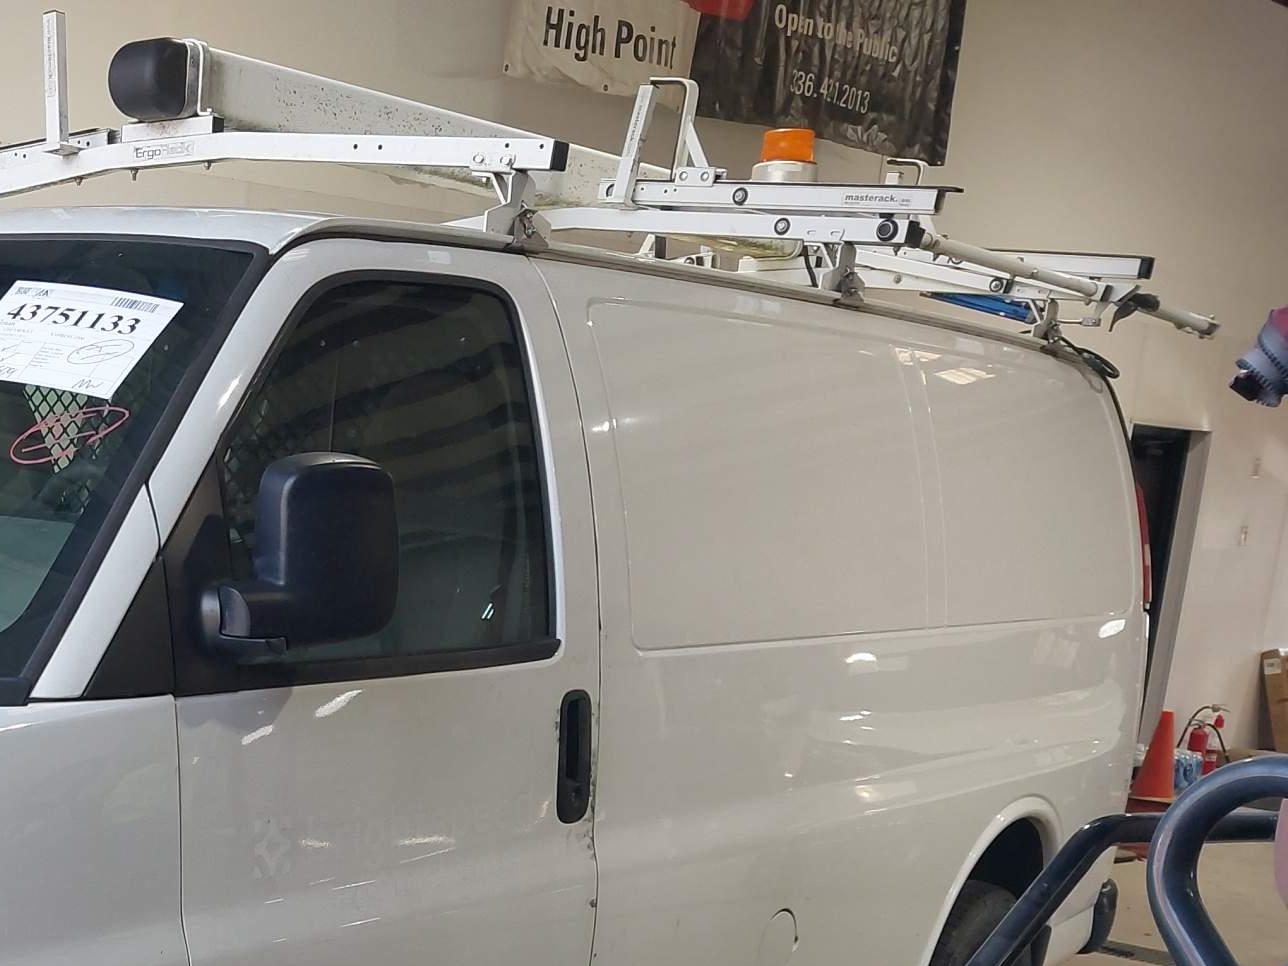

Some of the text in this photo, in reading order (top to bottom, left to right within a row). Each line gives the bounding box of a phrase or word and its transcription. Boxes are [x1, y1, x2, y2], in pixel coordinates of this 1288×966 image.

[542, 6, 677, 70] High Point
[775, 4, 899, 63] Open to the Public
[7, 303, 142, 335] 43751133
